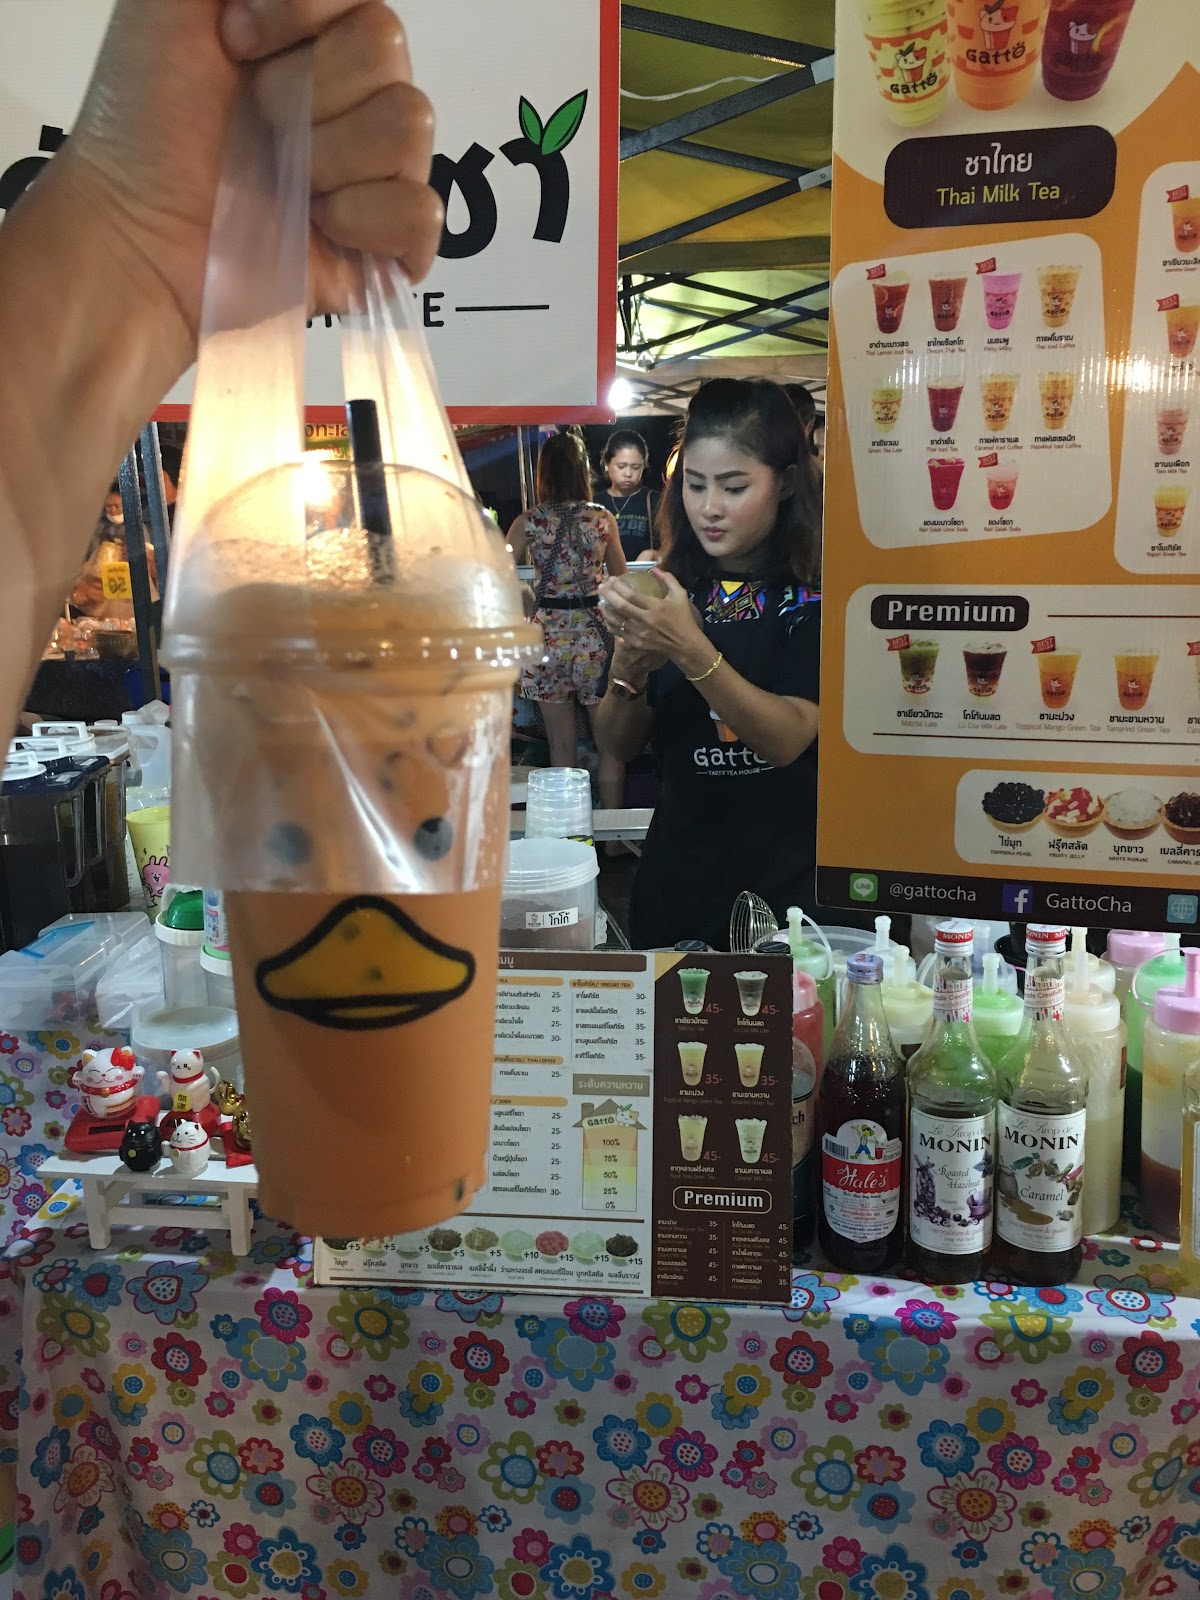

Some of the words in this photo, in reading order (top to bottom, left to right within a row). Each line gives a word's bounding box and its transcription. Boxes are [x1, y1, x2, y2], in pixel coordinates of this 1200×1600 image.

[966, 41, 1026, 65] Gatto
[890, 72, 938, 95] Gatto
[965, 142, 1033, 176] ชาไทย
[937, 187, 976, 207] Thai
[982, 183, 1020, 204] Milk
[1027, 182, 1060, 200] Tea
[887, 600, 1017, 623] Premium
[896, 708, 943, 718] ชาเขียวมัทฉะ
[962, 709, 1001, 721] โกโก้นมสด
[1039, 711, 1075, 721] ชามะม่วง
[1109, 715, 1165, 724] ชามะขามหวาน
[1043, 723, 1066, 732] Mango
[1106, 724, 1136, 732] Tamarind
[1136, 725, 1157, 733] Green
[1157, 725, 1170, 733] Tea
[738, 766, 761, 776] HOUSE
[998, 834, 1023, 850] ไข่มุก
[1113, 844, 1144, 856] บุกขาว
[889, 882, 977, 902] @gattocha
[1046, 892, 1133, 913] GattoCha
[548, 911, 570, 926] โกโก้
[942, 931, 973, 941] MONIN
[578, 1078, 644, 1090] ระดับความหวาน
[732, 1091, 770, 1099] ชามะขามหวาน
[587, 1114, 615, 1127] Gatto
[602, 1138, 621, 1146] 100%
[919, 1132, 991, 1153] MONIN
[1004, 1125, 1079, 1150] MONIN
[603, 1155, 618, 1163] 75%
[603, 1170, 618, 1179] 50%
[837, 1164, 887, 1189] Hale's
[938, 1164, 970, 1181] Roasted
[947, 1179, 981, 1189] Hazelnut
[603, 1187, 618, 1195] 25%
[1020, 1185, 1064, 1201] Caramel
[605, 1201, 616, 1209] 0%
[683, 1190, 763, 1208] Premium
[349, 1243, 361, 1251] +5
[384, 1243, 396, 1251] +5
[418, 1245, 430, 1253] +5
[453, 1249, 465, 1257] +5
[489, 1249, 502, 1257] +5
[523, 1250, 539, 1259] +10
[559, 1253, 574, 1262] +15
[594, 1254, 610, 1262] +15
[628, 1257, 643, 1265] +15
[334, 1257, 348, 1267] ไข่มุก
[400, 1262, 419, 1270] บุกขาว
